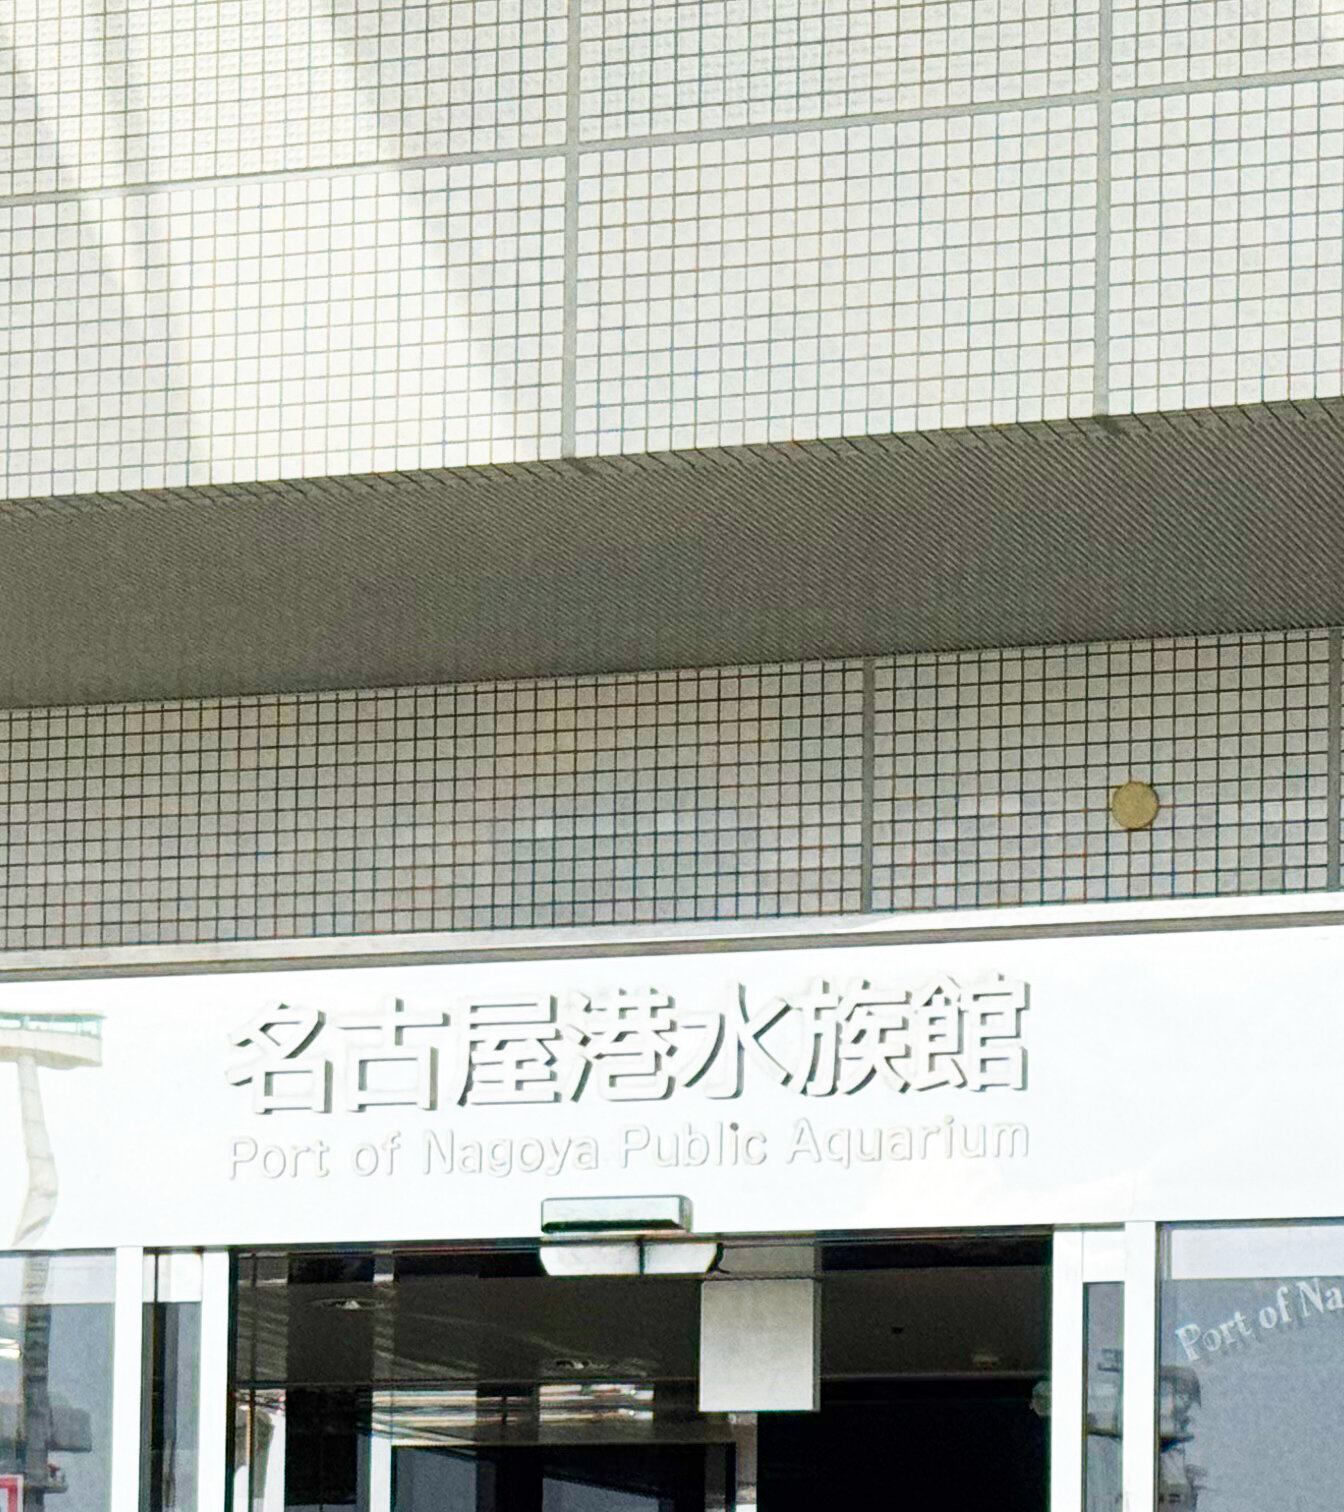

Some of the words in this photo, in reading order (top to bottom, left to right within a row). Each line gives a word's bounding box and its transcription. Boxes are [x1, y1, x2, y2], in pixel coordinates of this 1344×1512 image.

[226, 972, 1031, 1117] 名古屋港水族館
[229, 1135, 330, 1181] Port
[353, 1130, 402, 1177] of
[422, 1127, 599, 1178] Nagoya
[621, 1121, 767, 1169] Public
[786, 1115, 1030, 1169] Aquarium
[1175, 1311, 1253, 1362] Port
[1259, 1286, 1292, 1329] of
